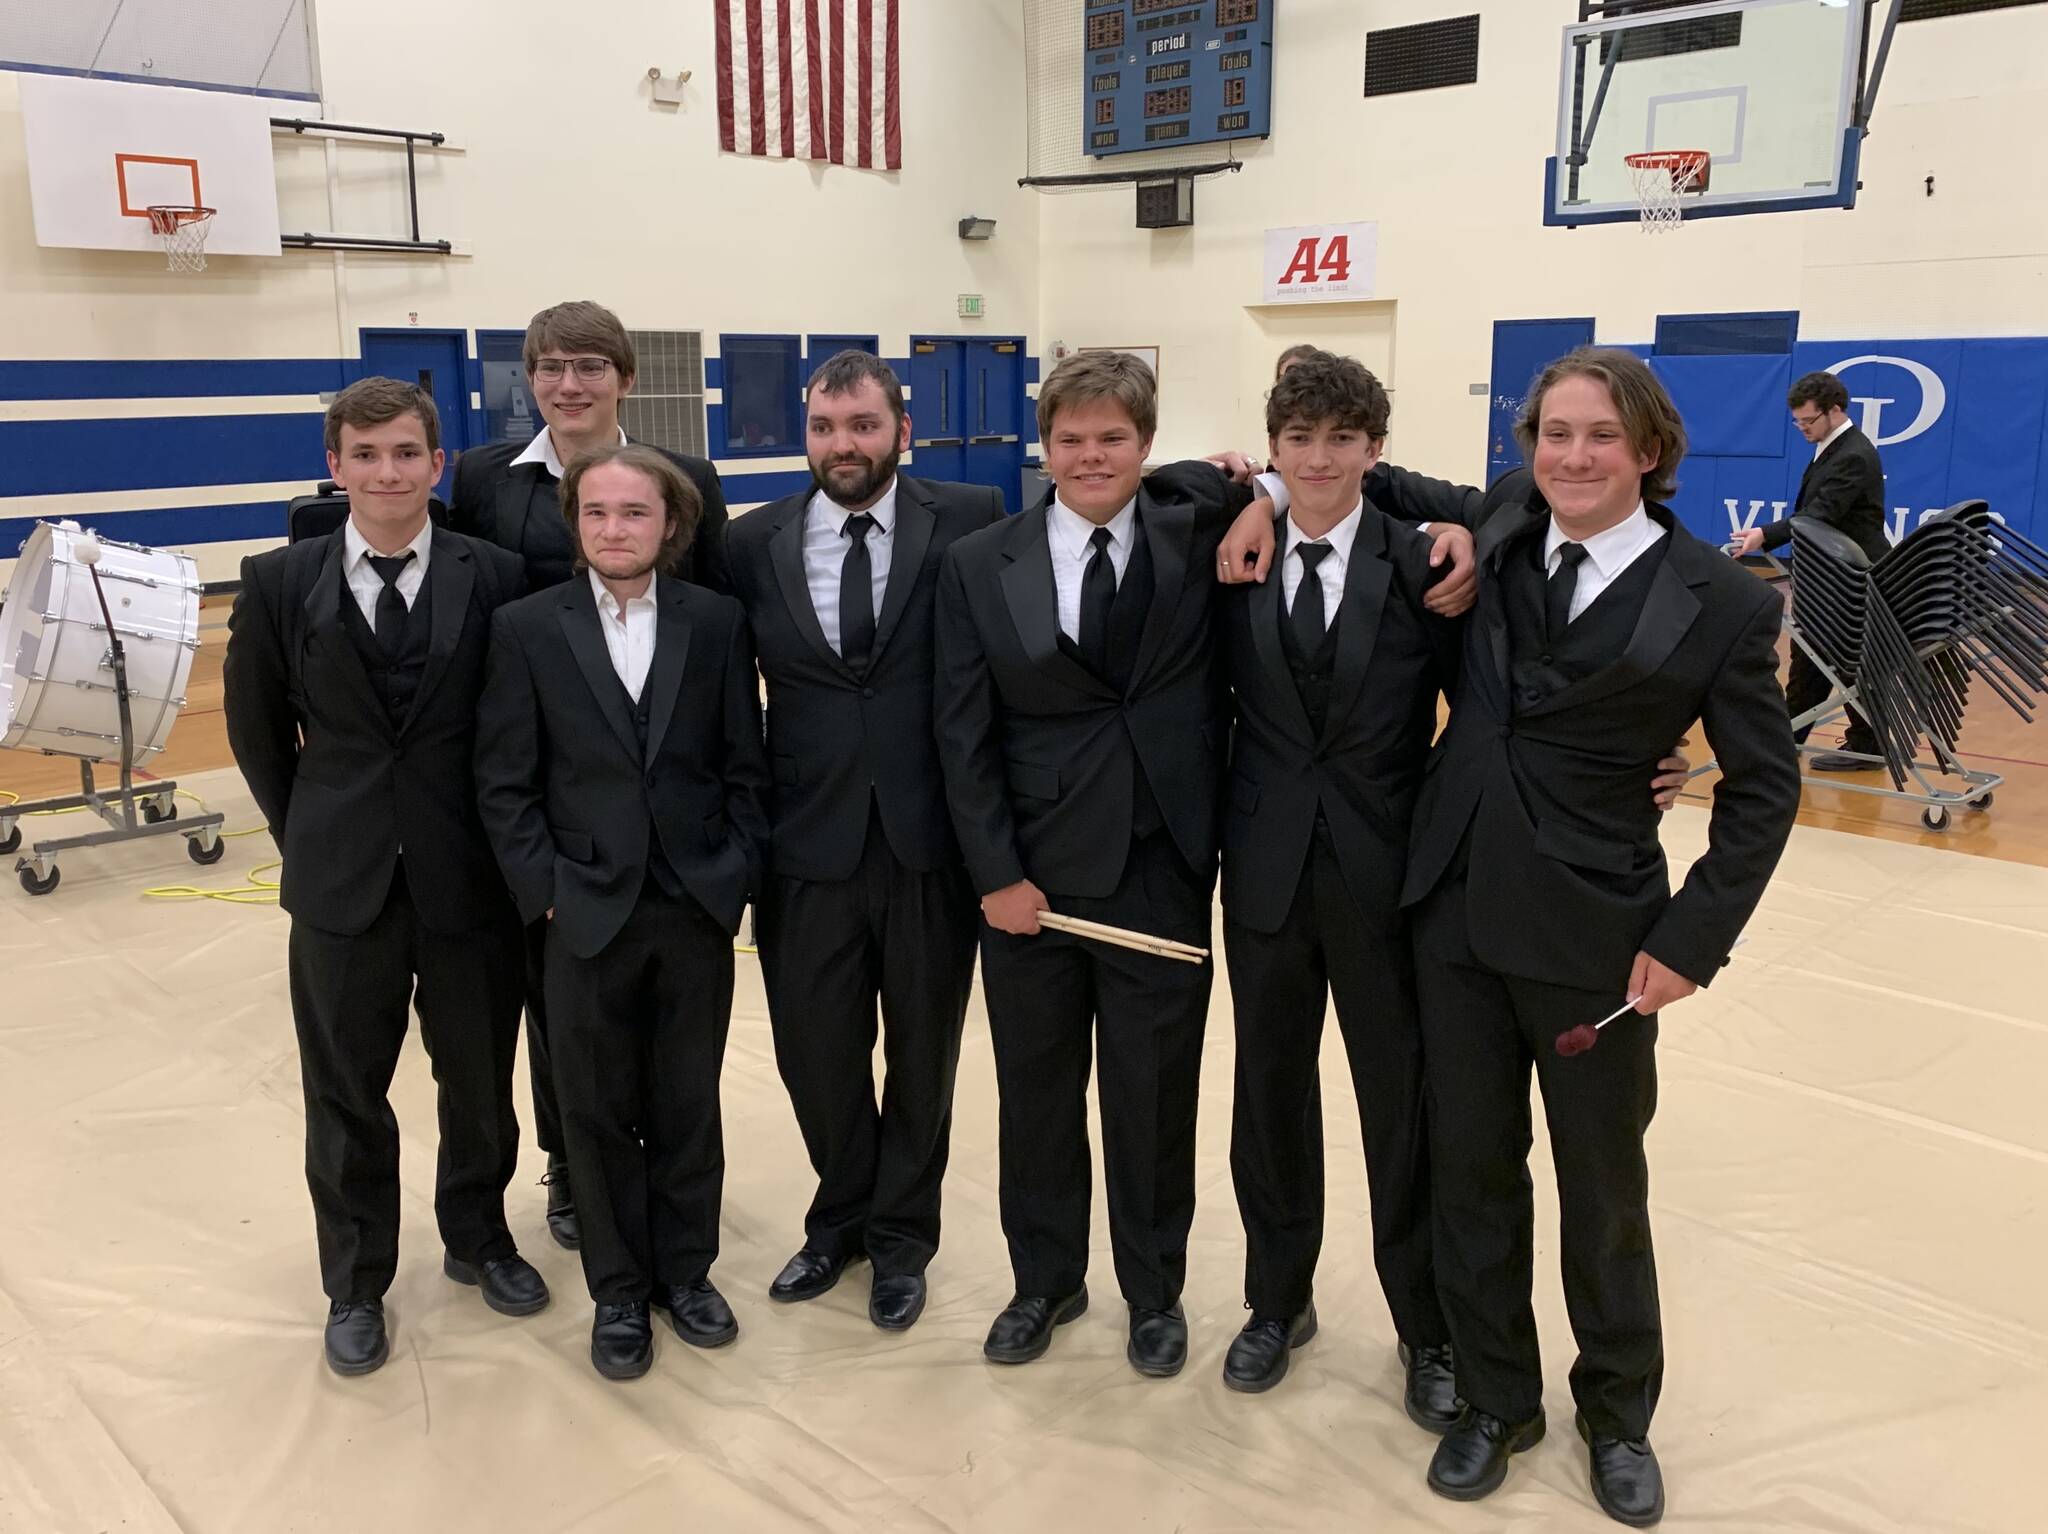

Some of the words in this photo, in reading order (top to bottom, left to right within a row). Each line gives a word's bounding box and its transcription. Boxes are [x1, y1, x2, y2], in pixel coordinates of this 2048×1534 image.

[1151, 33, 1185, 55] period
[1222, 52, 1248, 70] fouls
[1151, 64, 1185, 83] player
[1094, 75, 1117, 91] fouls
[1223, 114, 1245, 129] won
[1095, 133, 1115, 146] won
[1277, 235, 1351, 284] A4
[1310, 285, 1325, 293] the
[965, 298, 980, 313] EXIT
